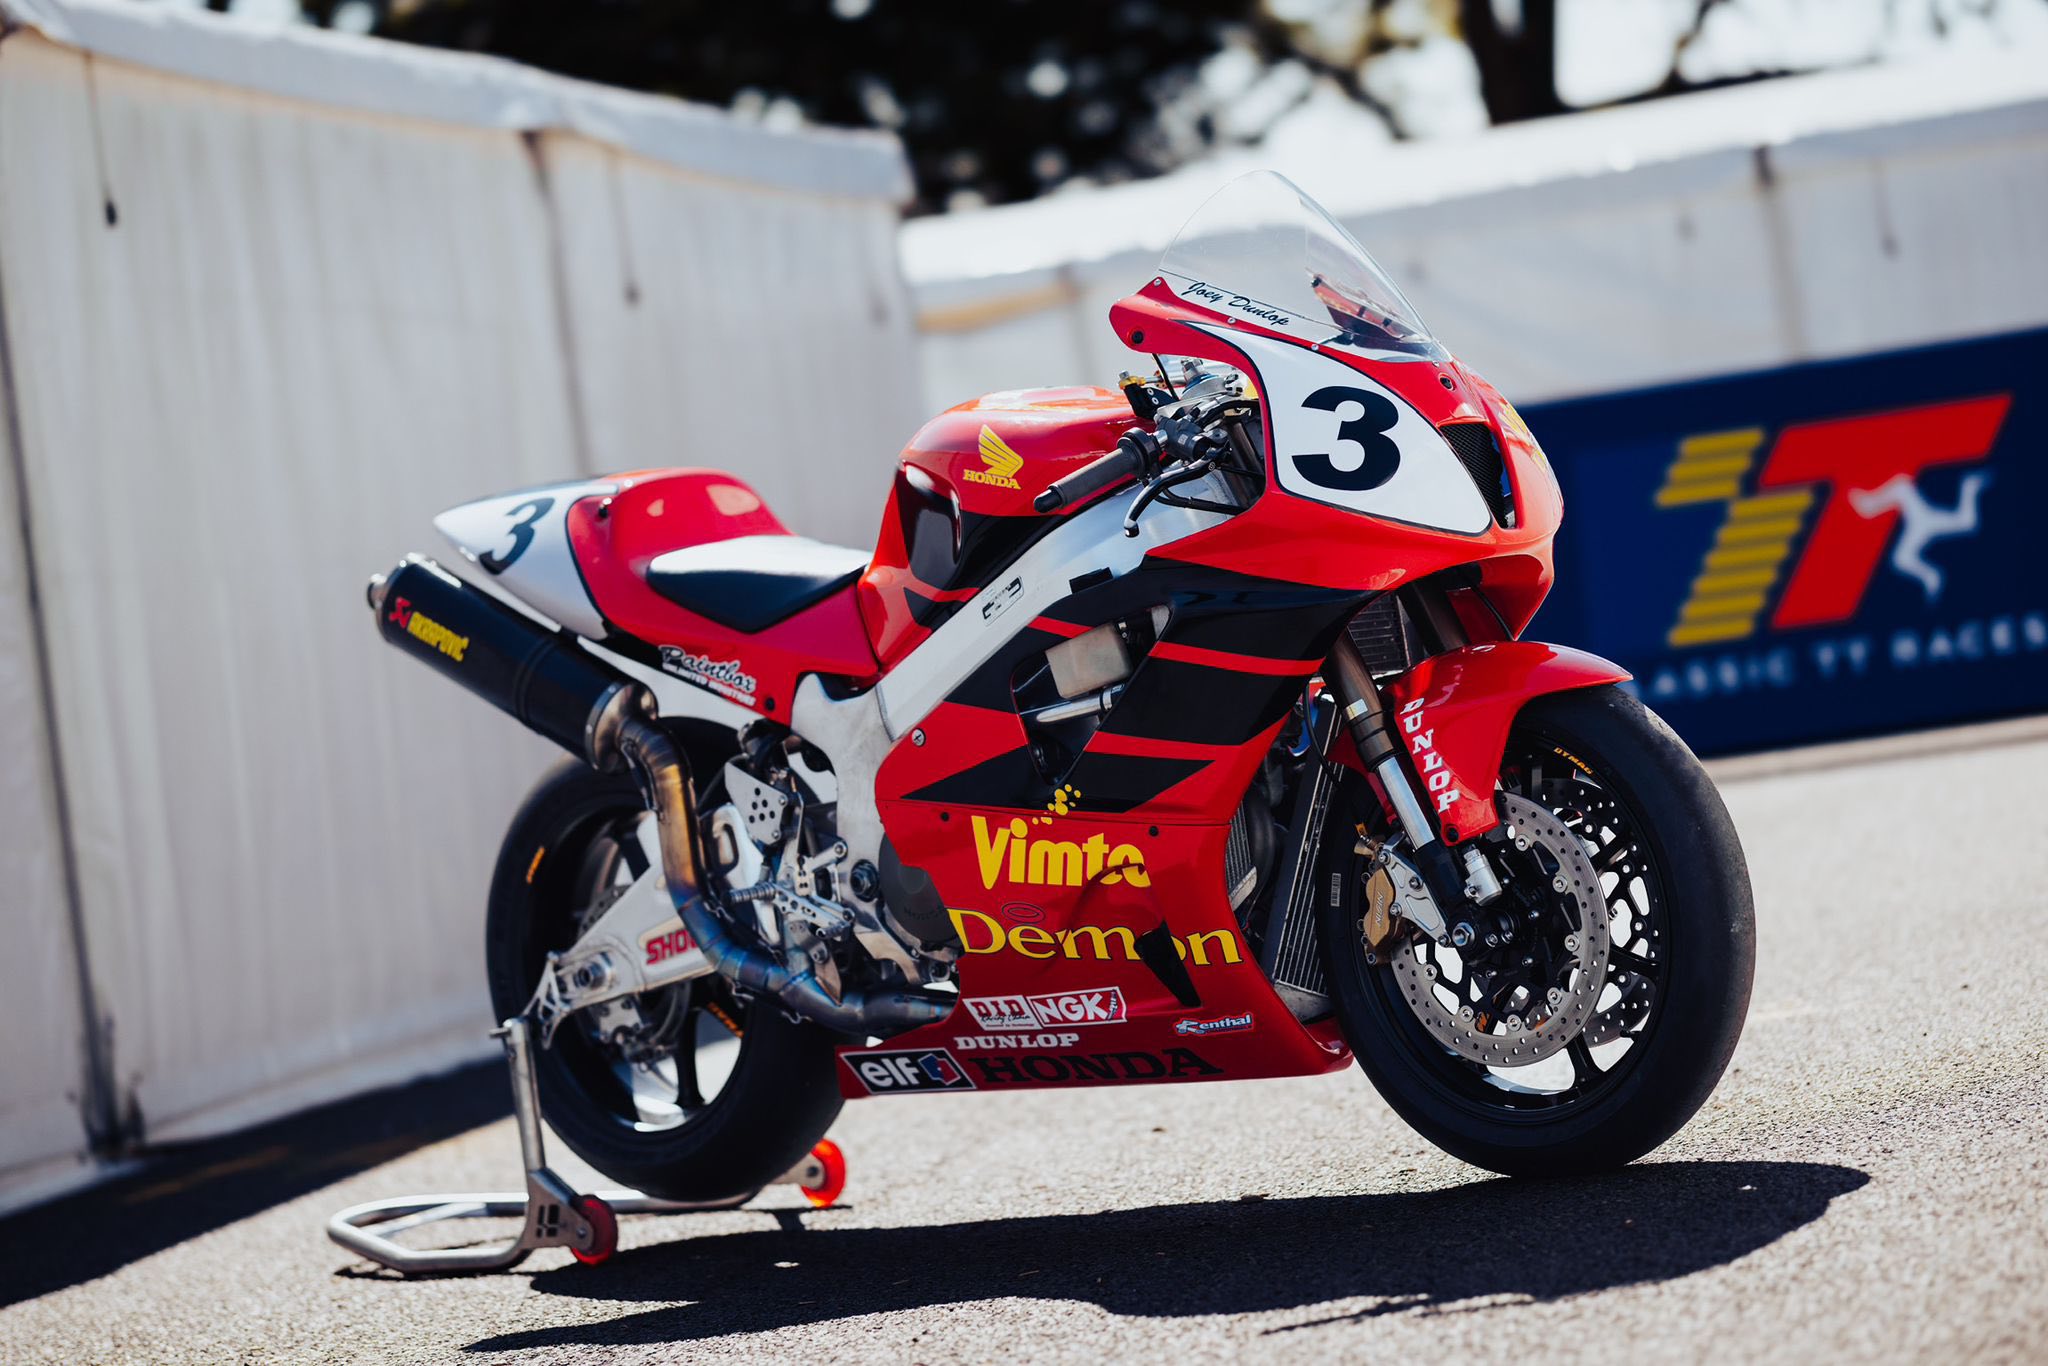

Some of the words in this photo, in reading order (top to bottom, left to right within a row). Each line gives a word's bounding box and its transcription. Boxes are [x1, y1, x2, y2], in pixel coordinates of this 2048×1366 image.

[1181, 282, 1223, 303] Joey
[1228, 295, 1289, 325] Dunlop
[1291, 385, 1401, 491] 3
[963, 469, 1021, 489] HONDA
[477, 498, 555, 575] 3
[659, 645, 757, 694] Paintbox
[1630, 647, 1793, 700] ASSIC
[1400, 698, 1460, 814] DUNLOP
[971, 815, 1152, 890] Vimto
[646, 928, 698, 966] SHO
[1033, 992, 1108, 1022] NGK
[1176, 1014, 1251, 1034] Renthal
[953, 1033, 1080, 1050] DUNLOP
[860, 1055, 922, 1088] elf
[968, 1047, 1224, 1084] HONDA
